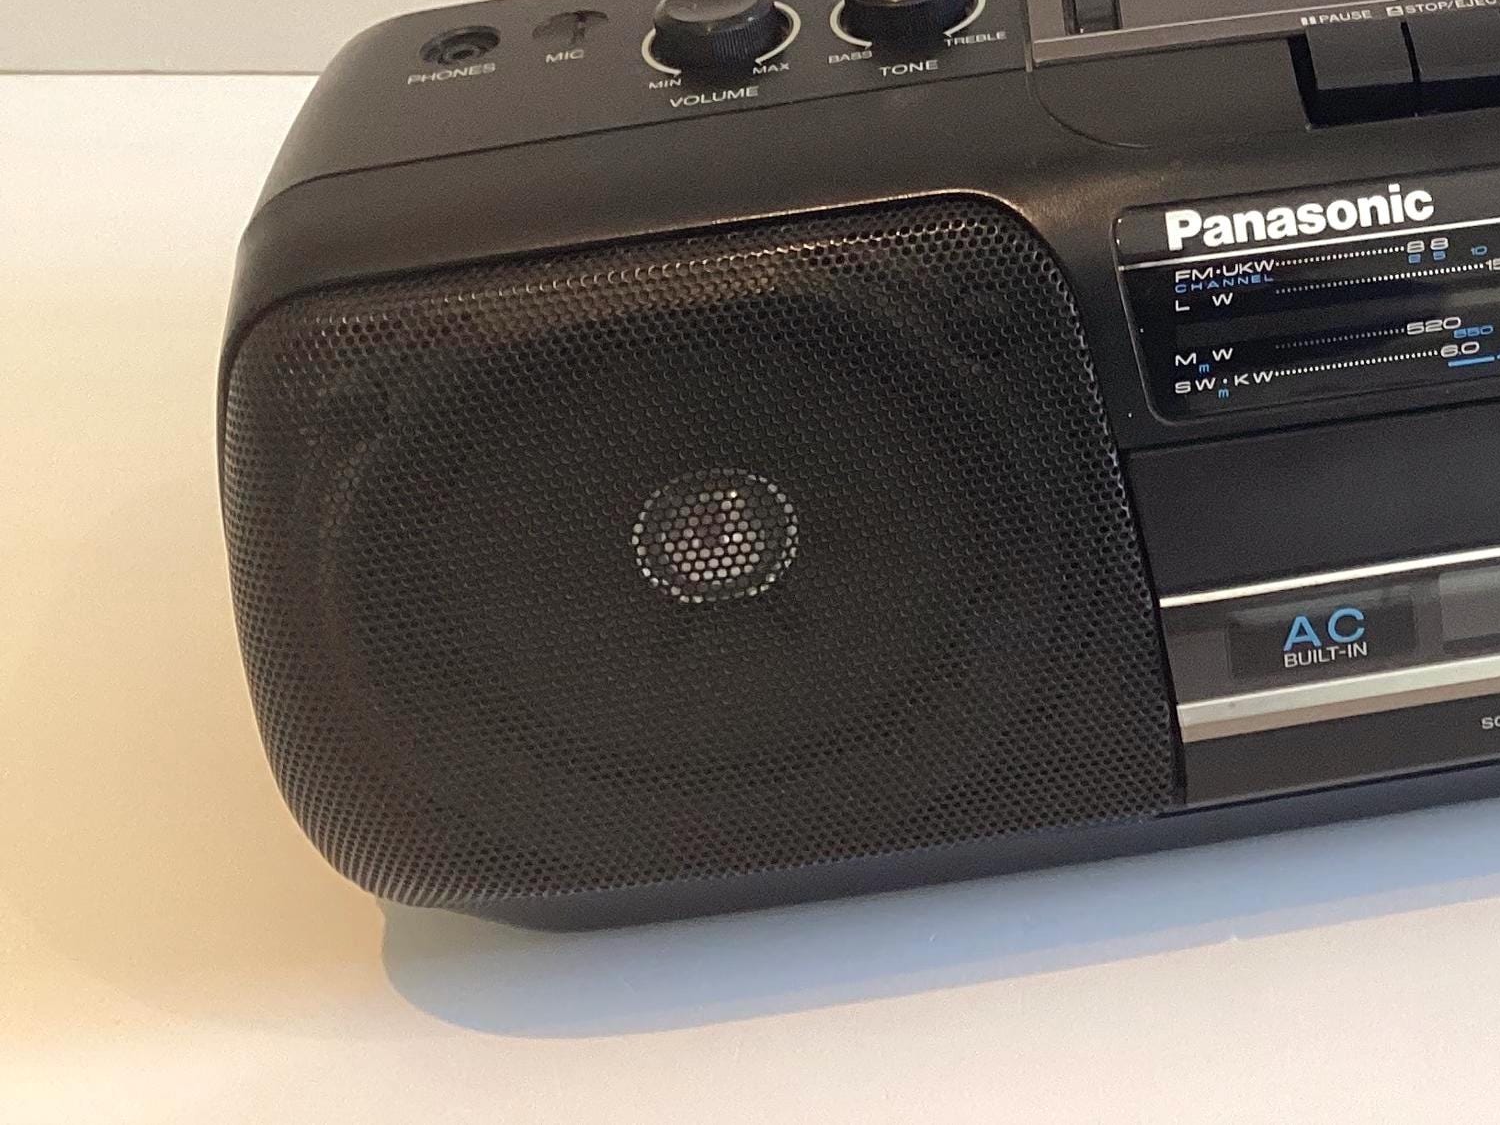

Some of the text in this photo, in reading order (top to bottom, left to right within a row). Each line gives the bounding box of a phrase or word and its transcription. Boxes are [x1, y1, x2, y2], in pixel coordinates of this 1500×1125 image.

[1317, 9, 1372, 24] PAUSE
[827, 30, 1008, 65] BASS TREBLE
[407, 48, 585, 85] PHONES MIC
[648, 62, 791, 90] MIN MAX
[879, 59, 940, 77] TONE
[669, 85, 760, 108] VOLUME
[1165, 183, 1435, 252] Panasonic
[1174, 274, 1275, 294] CHANNEL
[1406, 316, 1462, 336] 520
[1283, 641, 1369, 668] BUILT-IN
